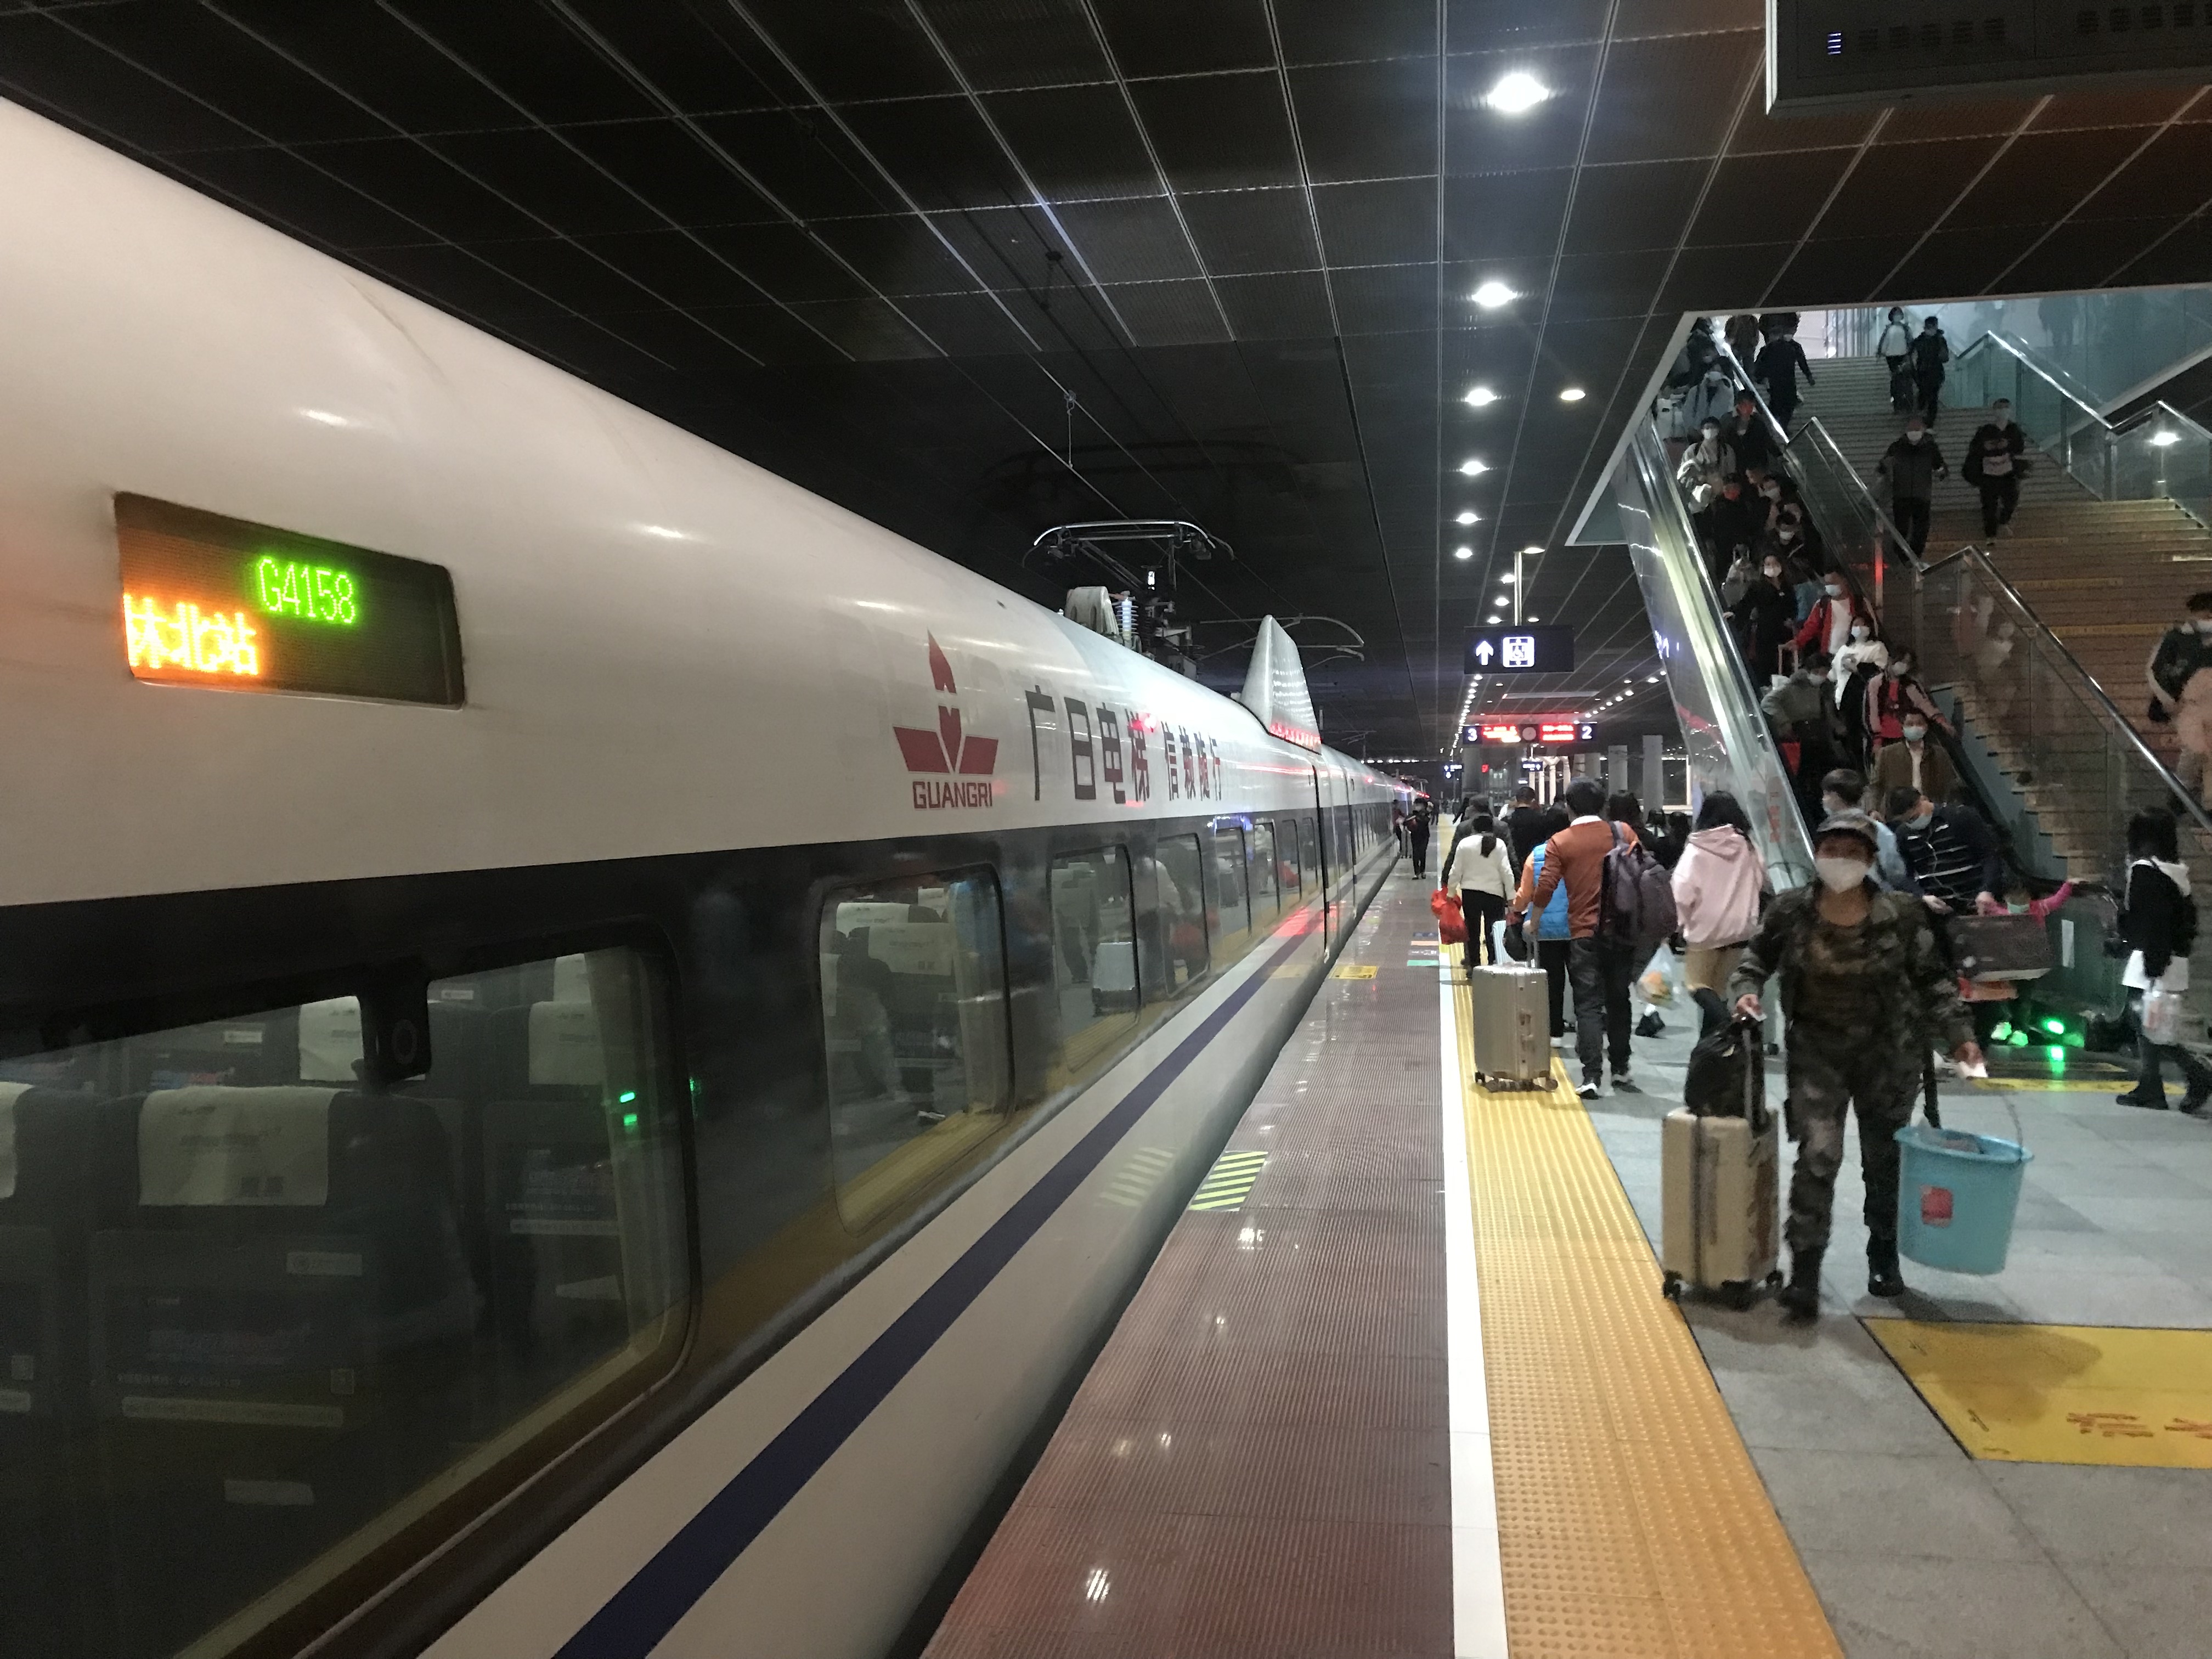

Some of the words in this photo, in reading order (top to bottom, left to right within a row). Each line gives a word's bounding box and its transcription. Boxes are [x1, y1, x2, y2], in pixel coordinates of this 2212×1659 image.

[257, 557, 357, 624] G4158
[1025, 685, 1150, 804] 广日电梯
[1468, 728, 1479, 742] 3
[1582, 726, 1593, 739] 2
[913, 781, 993, 809] GUANGRI
